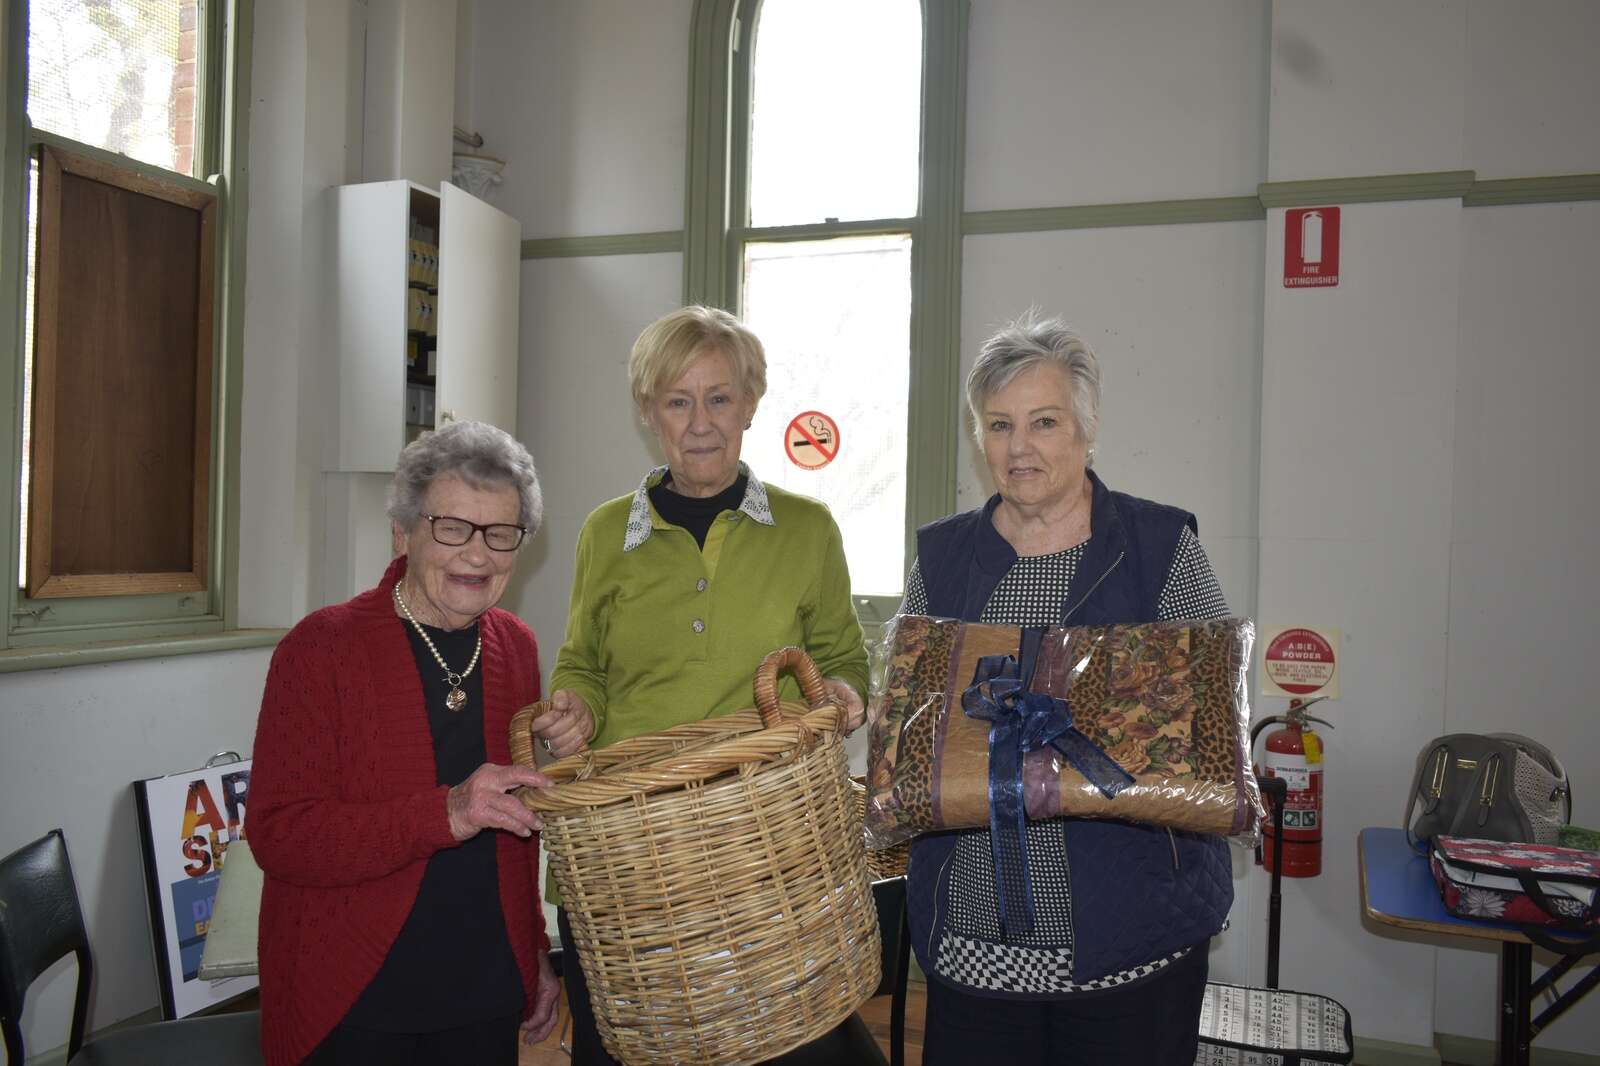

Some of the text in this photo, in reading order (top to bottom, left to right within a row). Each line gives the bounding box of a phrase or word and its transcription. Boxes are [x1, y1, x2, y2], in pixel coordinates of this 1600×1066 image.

[1302, 266, 1320, 274] FIRE
[1284, 276, 1338, 286] EXTINGUISHER
[1281, 651, 1322, 660] POWDER
[181, 770, 252, 840] AR
[1214, 1047, 1224, 1055] 24
[1212, 1058, 1223, 1066] 25
[1266, 1056, 1279, 1065] 38
